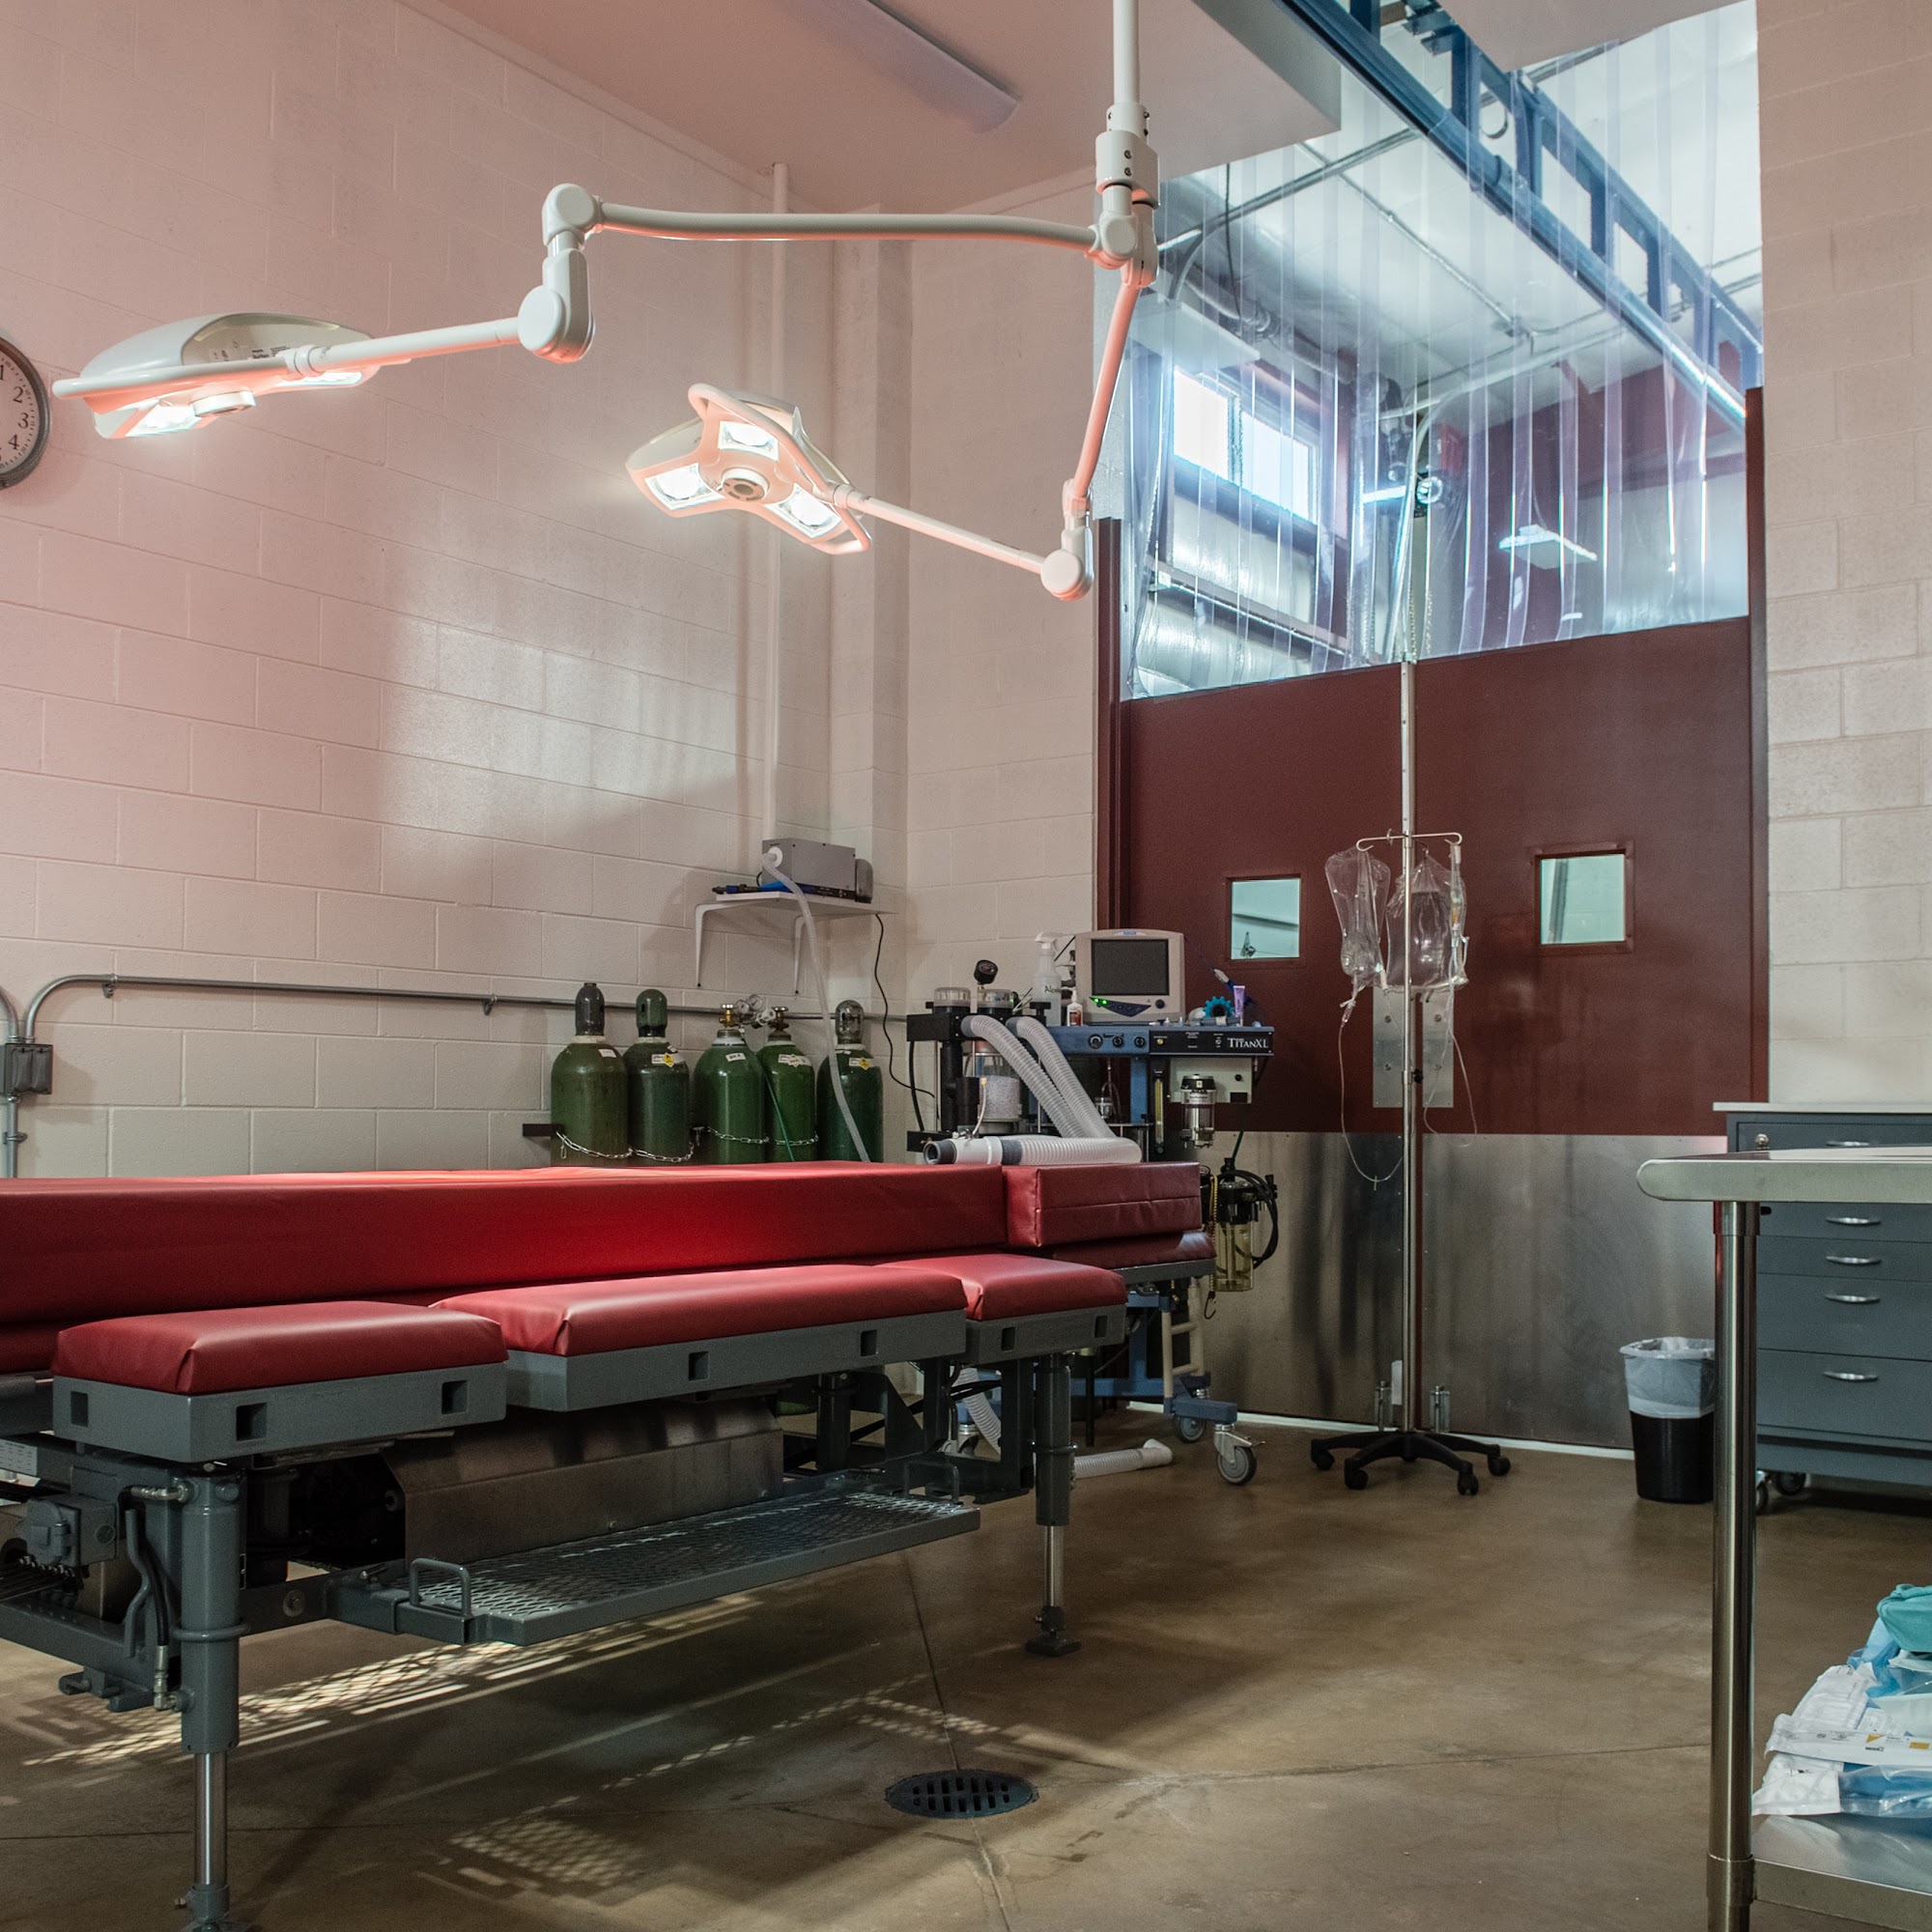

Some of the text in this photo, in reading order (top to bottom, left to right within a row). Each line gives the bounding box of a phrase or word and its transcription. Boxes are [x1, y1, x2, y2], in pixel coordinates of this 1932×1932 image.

[13, 385, 23, 404] 2
[17, 412, 29, 429] 3
[8, 434, 20, 450] 4
